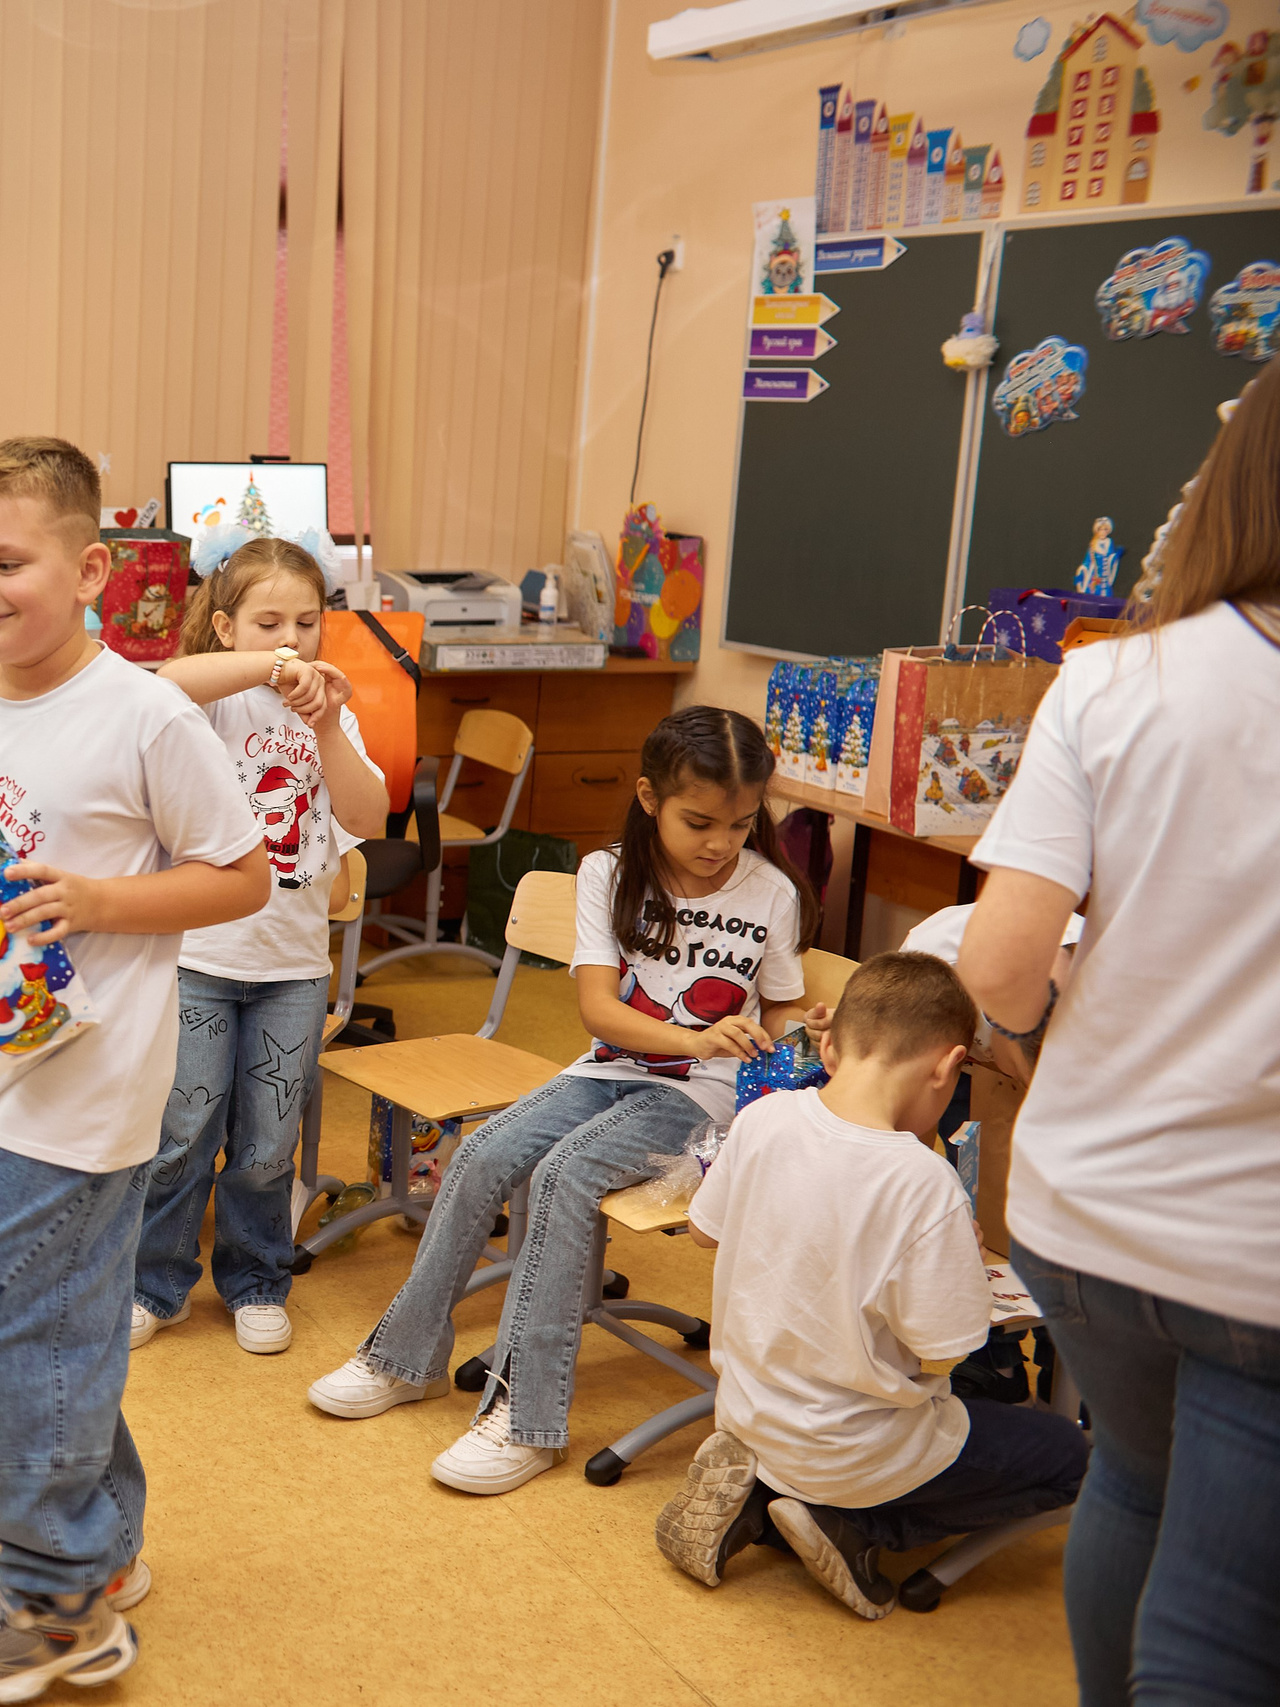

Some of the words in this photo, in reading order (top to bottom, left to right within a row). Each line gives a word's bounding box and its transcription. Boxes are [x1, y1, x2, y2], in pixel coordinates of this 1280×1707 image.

[279, 724, 318, 752] Merr
[179, 1007, 203, 1025] YES
[208, 1019, 228, 1040] NO
